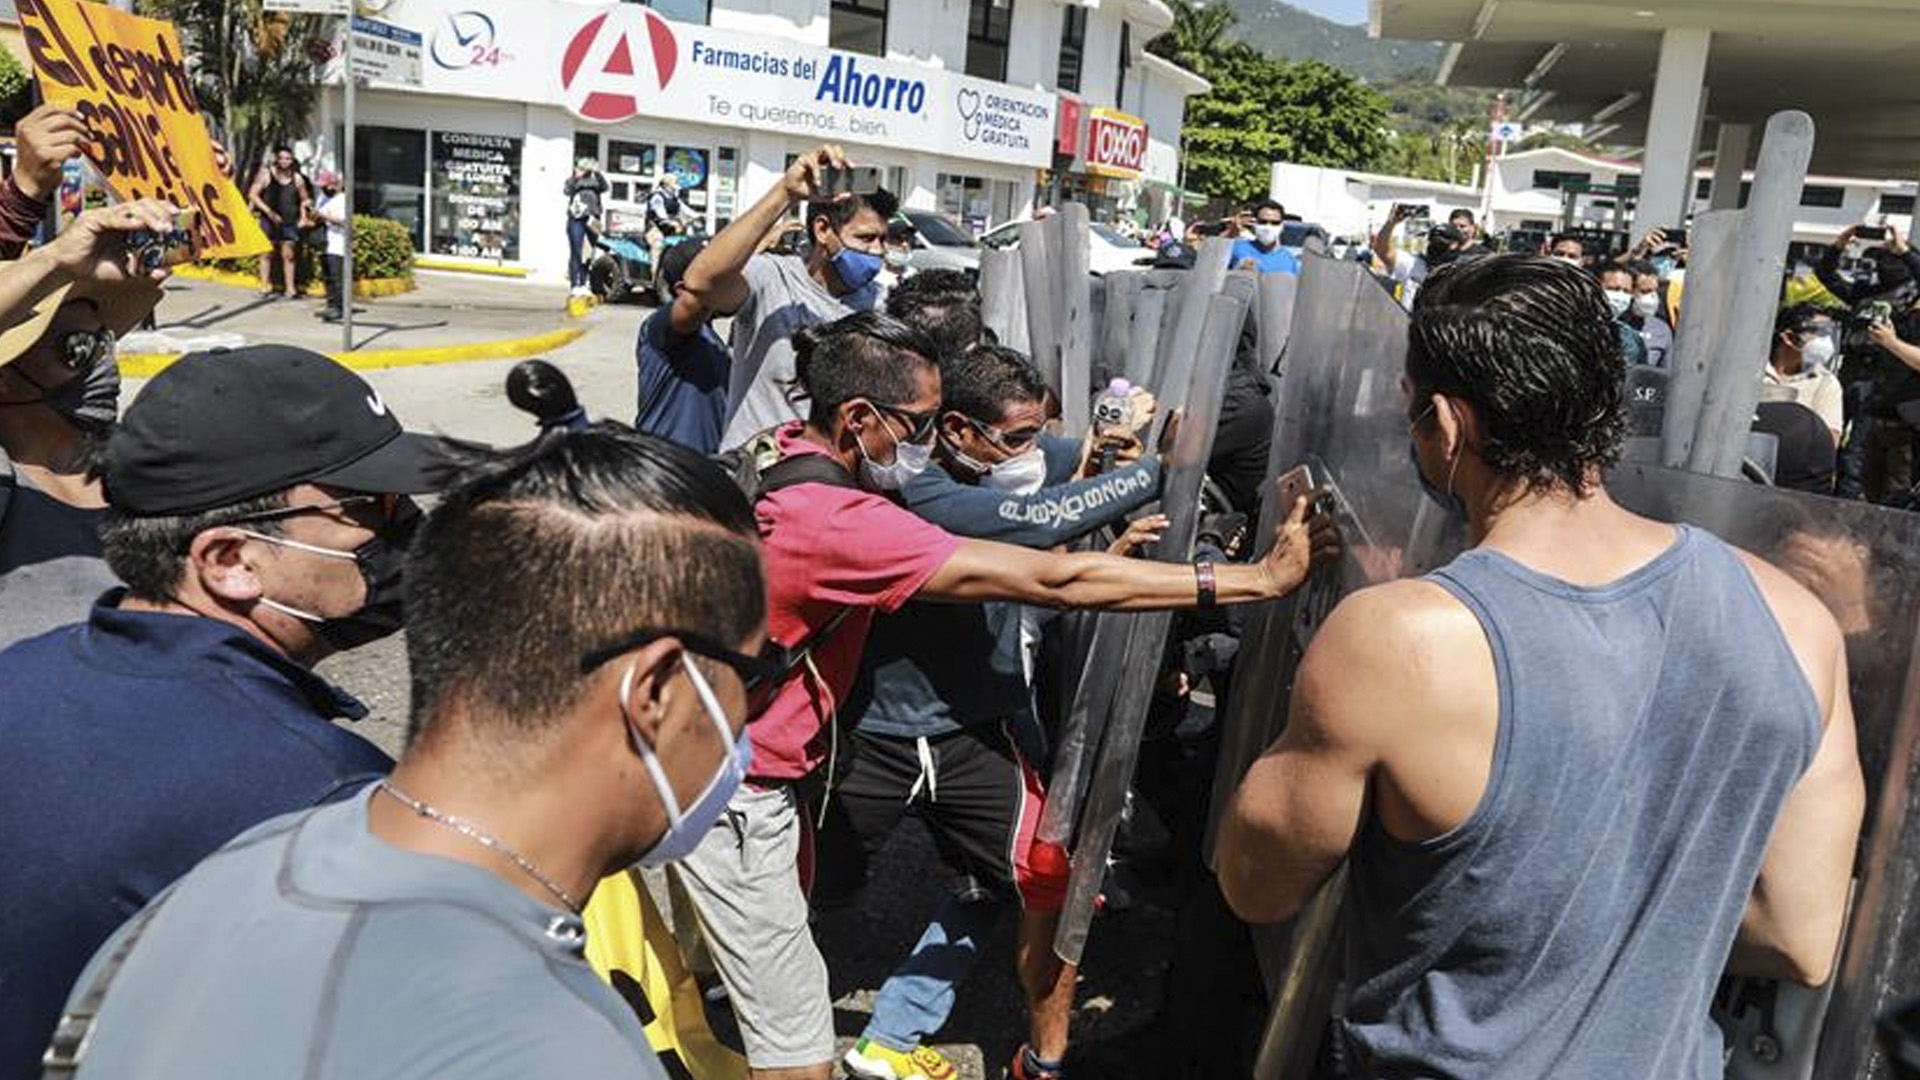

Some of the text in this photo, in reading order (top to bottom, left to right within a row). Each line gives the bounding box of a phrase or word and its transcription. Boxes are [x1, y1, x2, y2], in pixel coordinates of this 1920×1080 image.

[470, 45, 500, 65] 24
[692, 41, 925, 114] Farmacias del Ahorro
[708, 95, 732, 116] Te
[441, 132, 512, 149] CONSULTA
[981, 129, 1029, 150] GRATUITA
[1100, 123, 1141, 162] OXXO
[452, 147, 505, 163] MEDICA
[467, 205, 486, 217] DE
